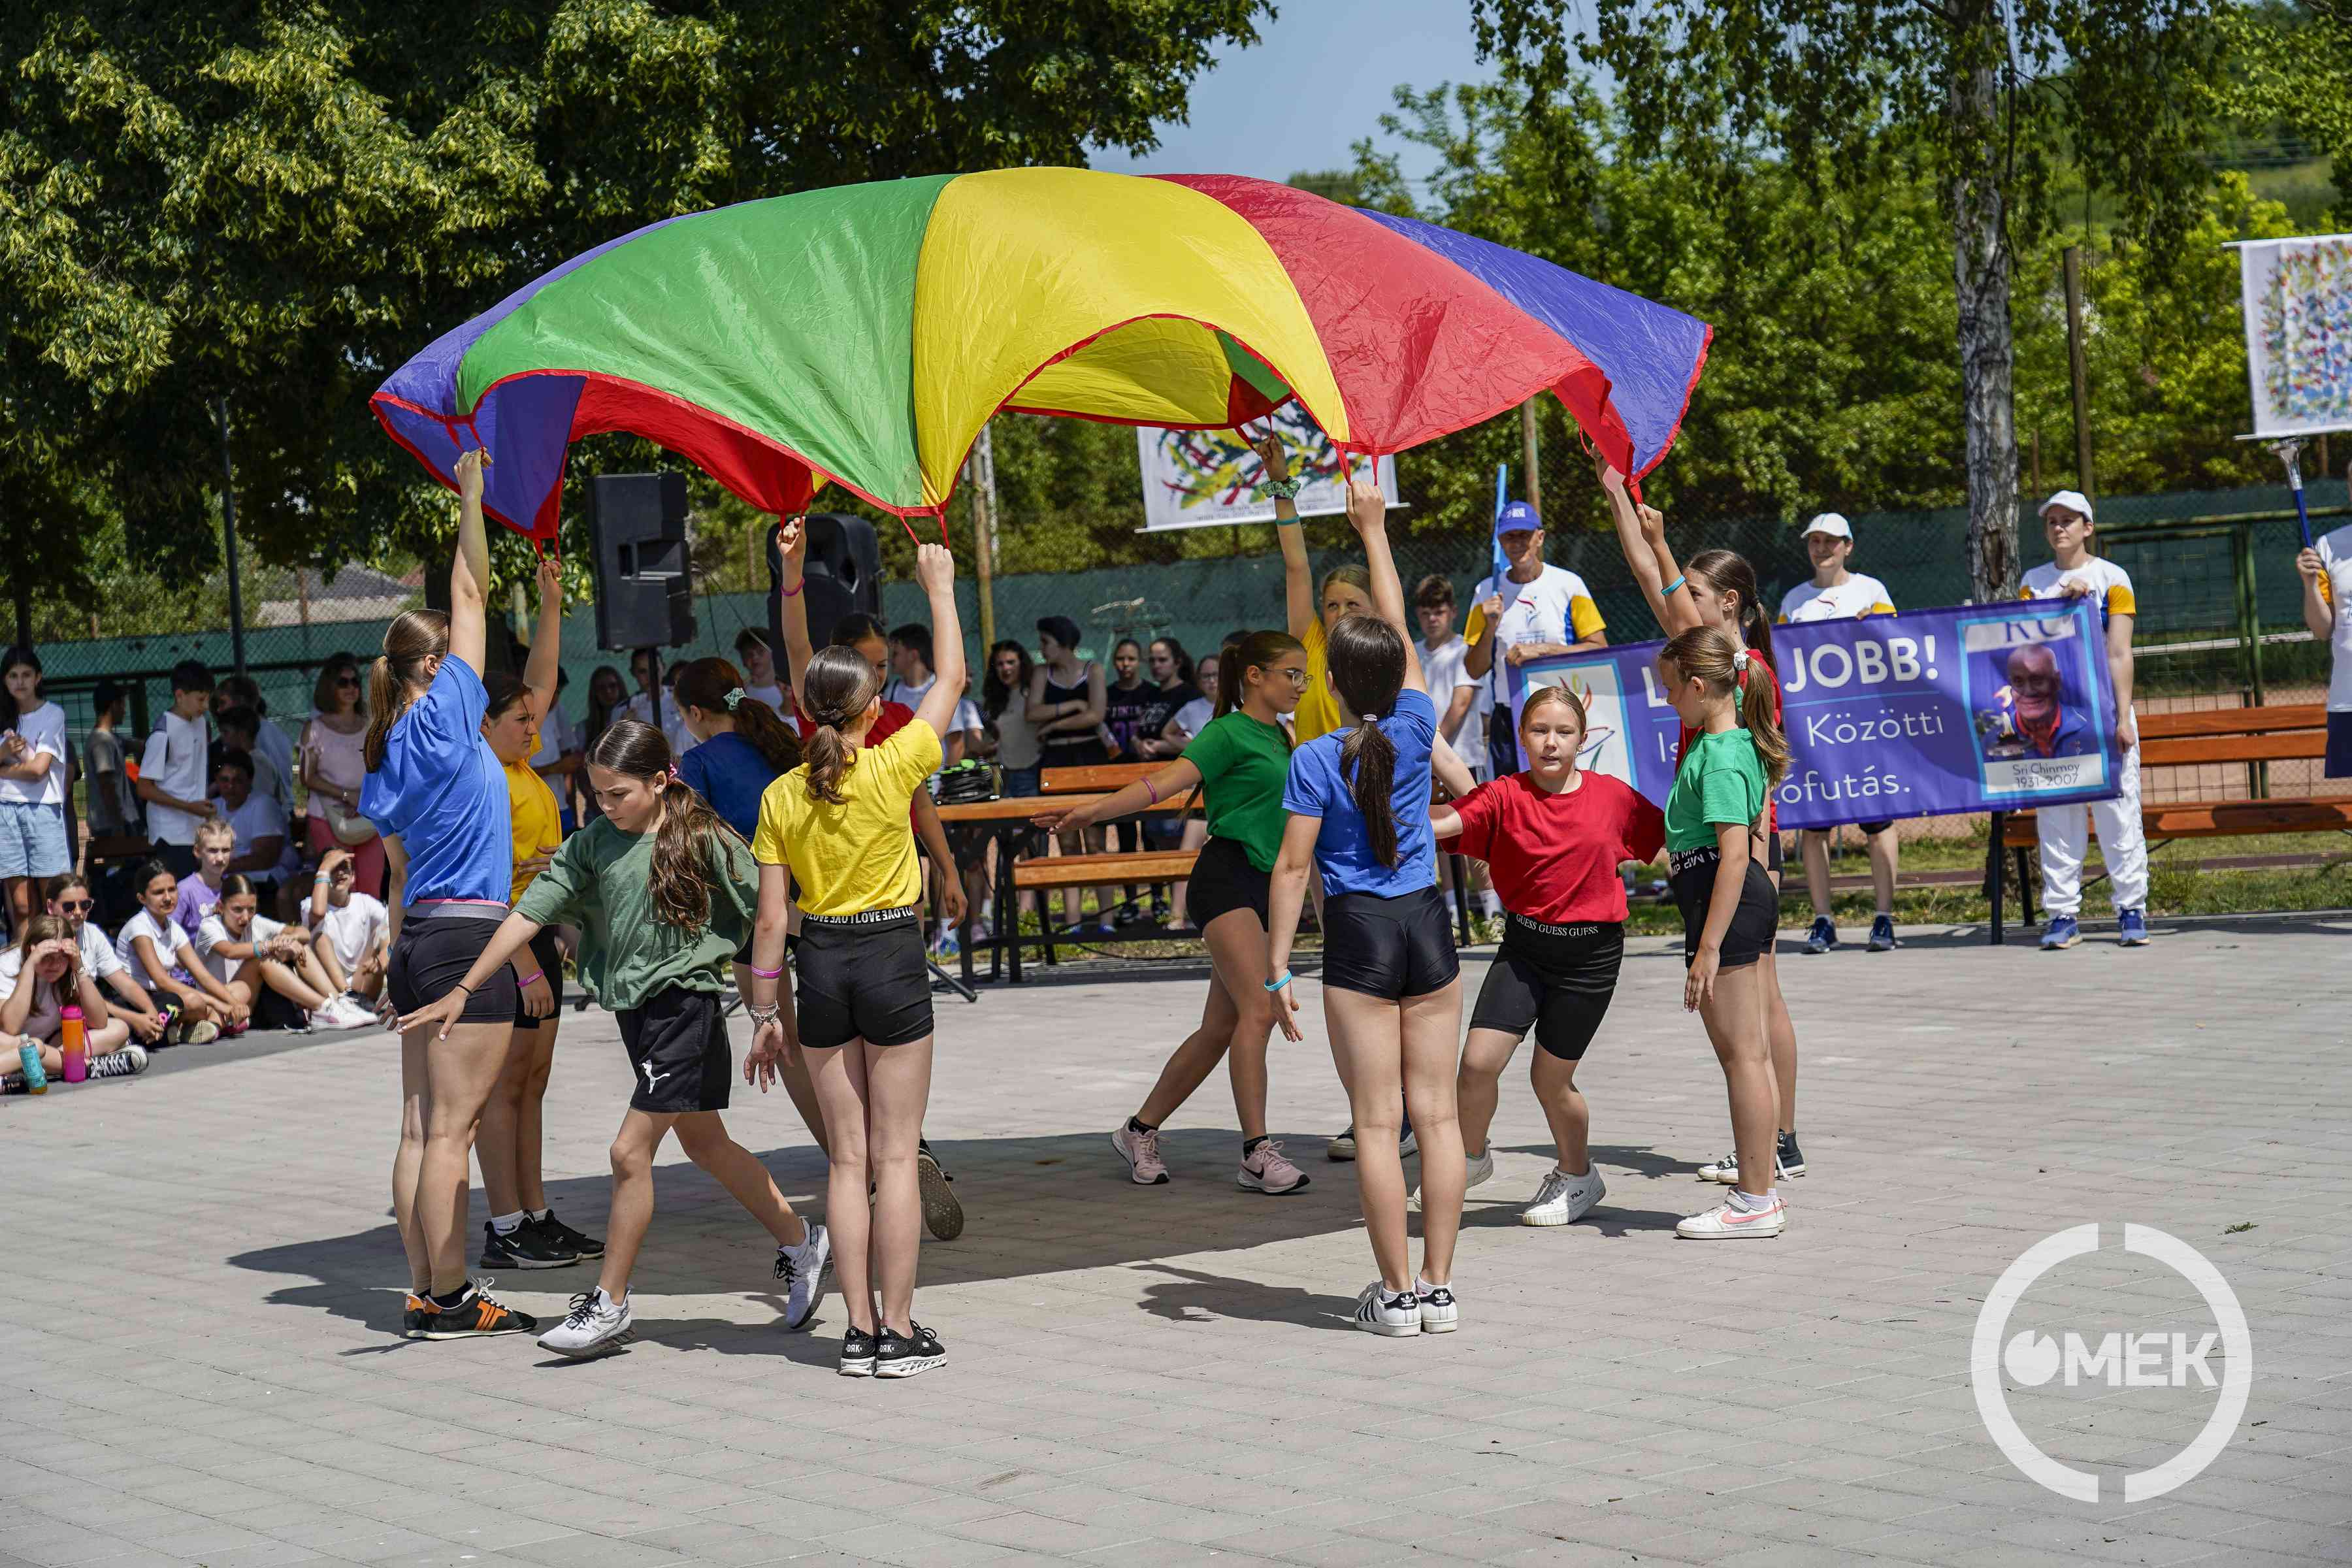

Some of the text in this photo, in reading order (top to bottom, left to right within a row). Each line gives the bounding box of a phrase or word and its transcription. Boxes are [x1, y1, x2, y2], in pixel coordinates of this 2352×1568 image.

[1784, 634, 1939, 693] JOBB!
[1806, 705, 1944, 747] Közötti
[1772, 764, 1911, 805] ófutás.
[2012, 762, 2080, 776] Sri Chinmoy
[1516, 913, 1599, 937] GUESS GUESS GUESS
[1570, 1189, 1584, 1200] FILA
